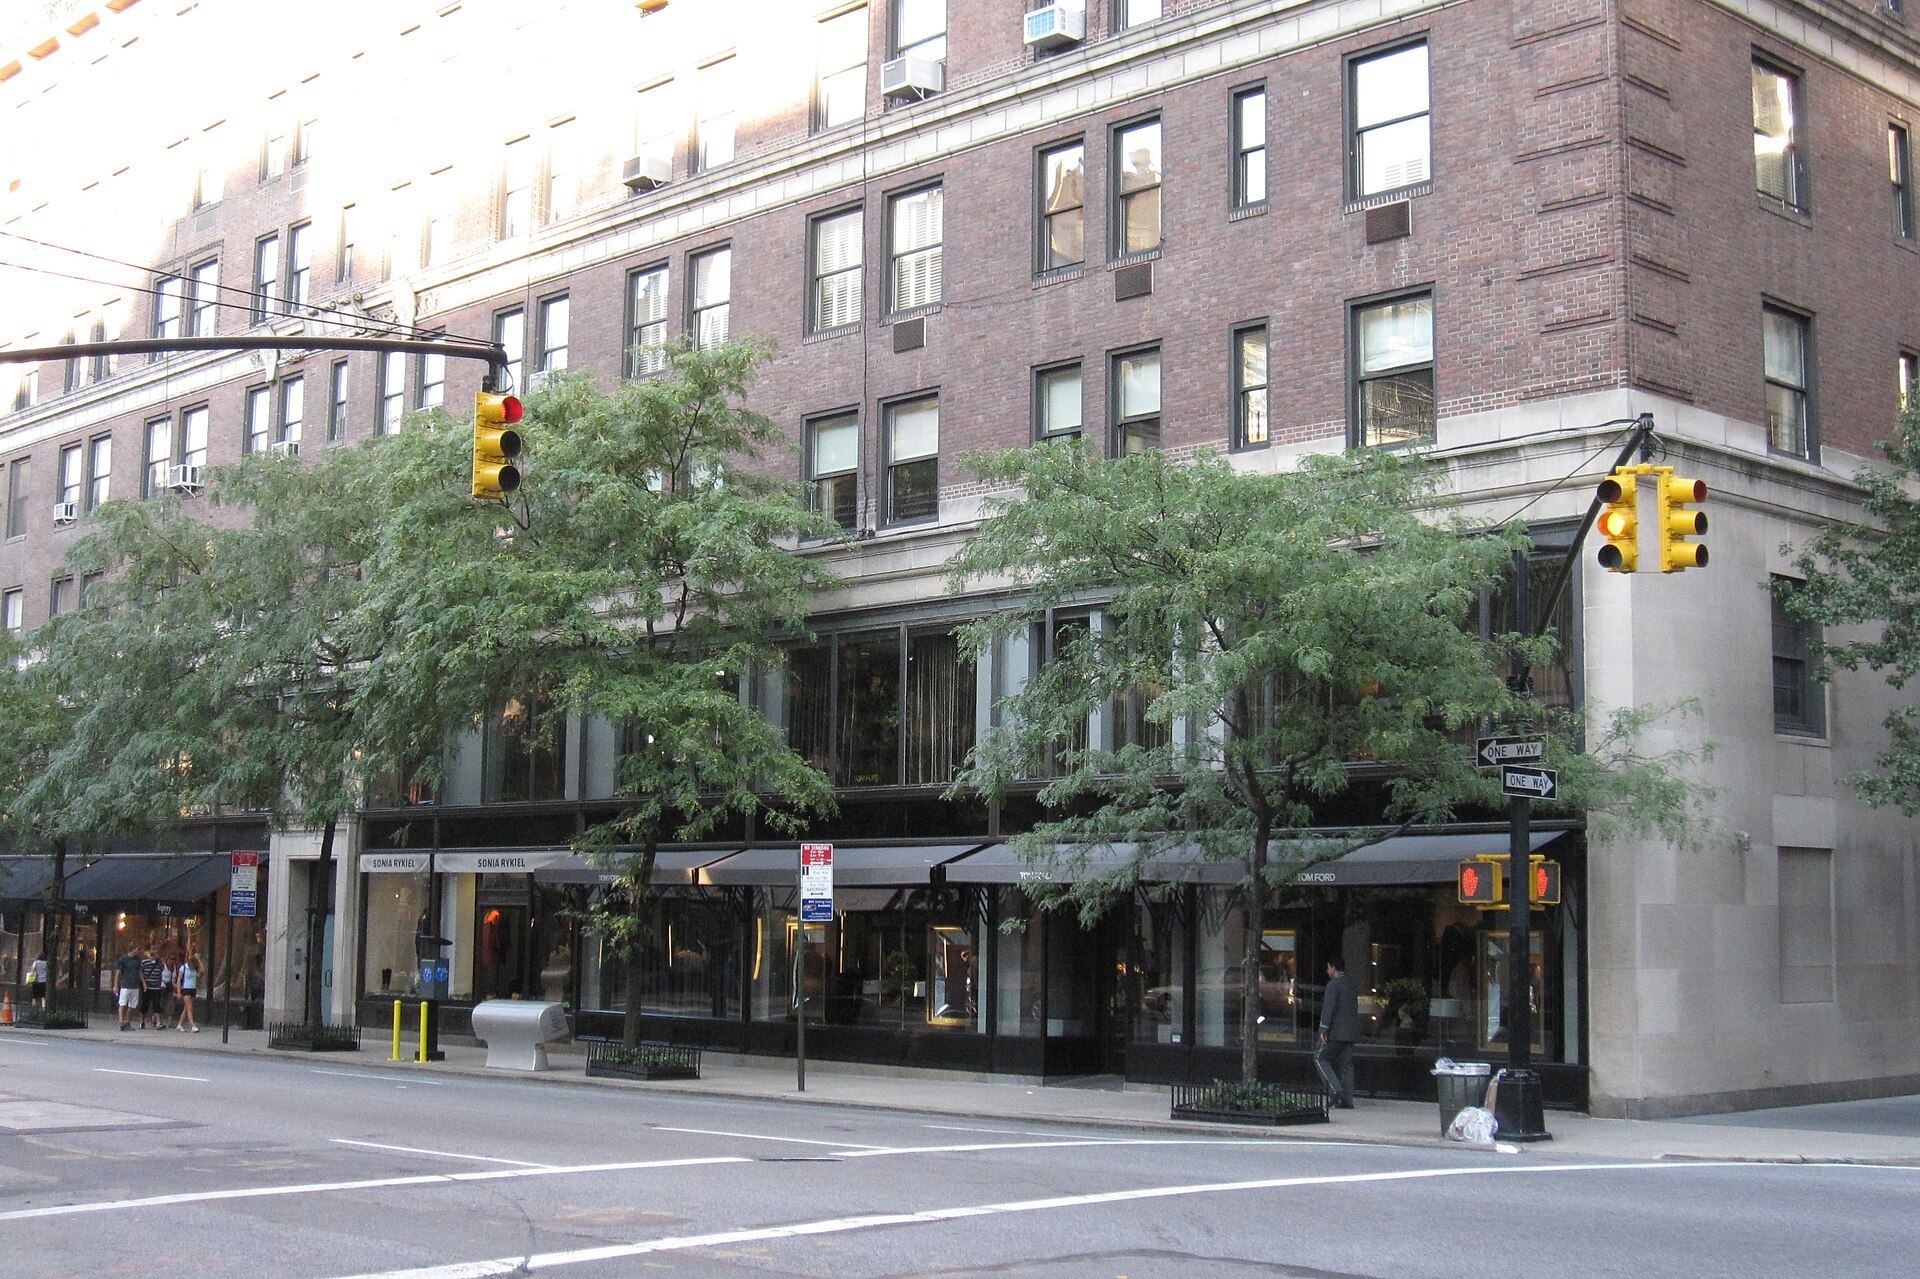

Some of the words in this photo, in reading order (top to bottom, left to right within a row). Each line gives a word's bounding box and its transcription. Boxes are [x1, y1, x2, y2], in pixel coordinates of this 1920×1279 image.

[1487, 745, 1507, 758] ONE
[1516, 743, 1538, 756] WAY
[1510, 774, 1526, 787] ONE
[1532, 777, 1549, 790] WAY
[373, 859, 393, 868] SONIA
[393, 859, 415, 868] RYKIEL
[477, 858, 500, 868] SONIA
[500, 858, 526, 868] RYKIEL
[1314, 873, 1336, 881] FORD
